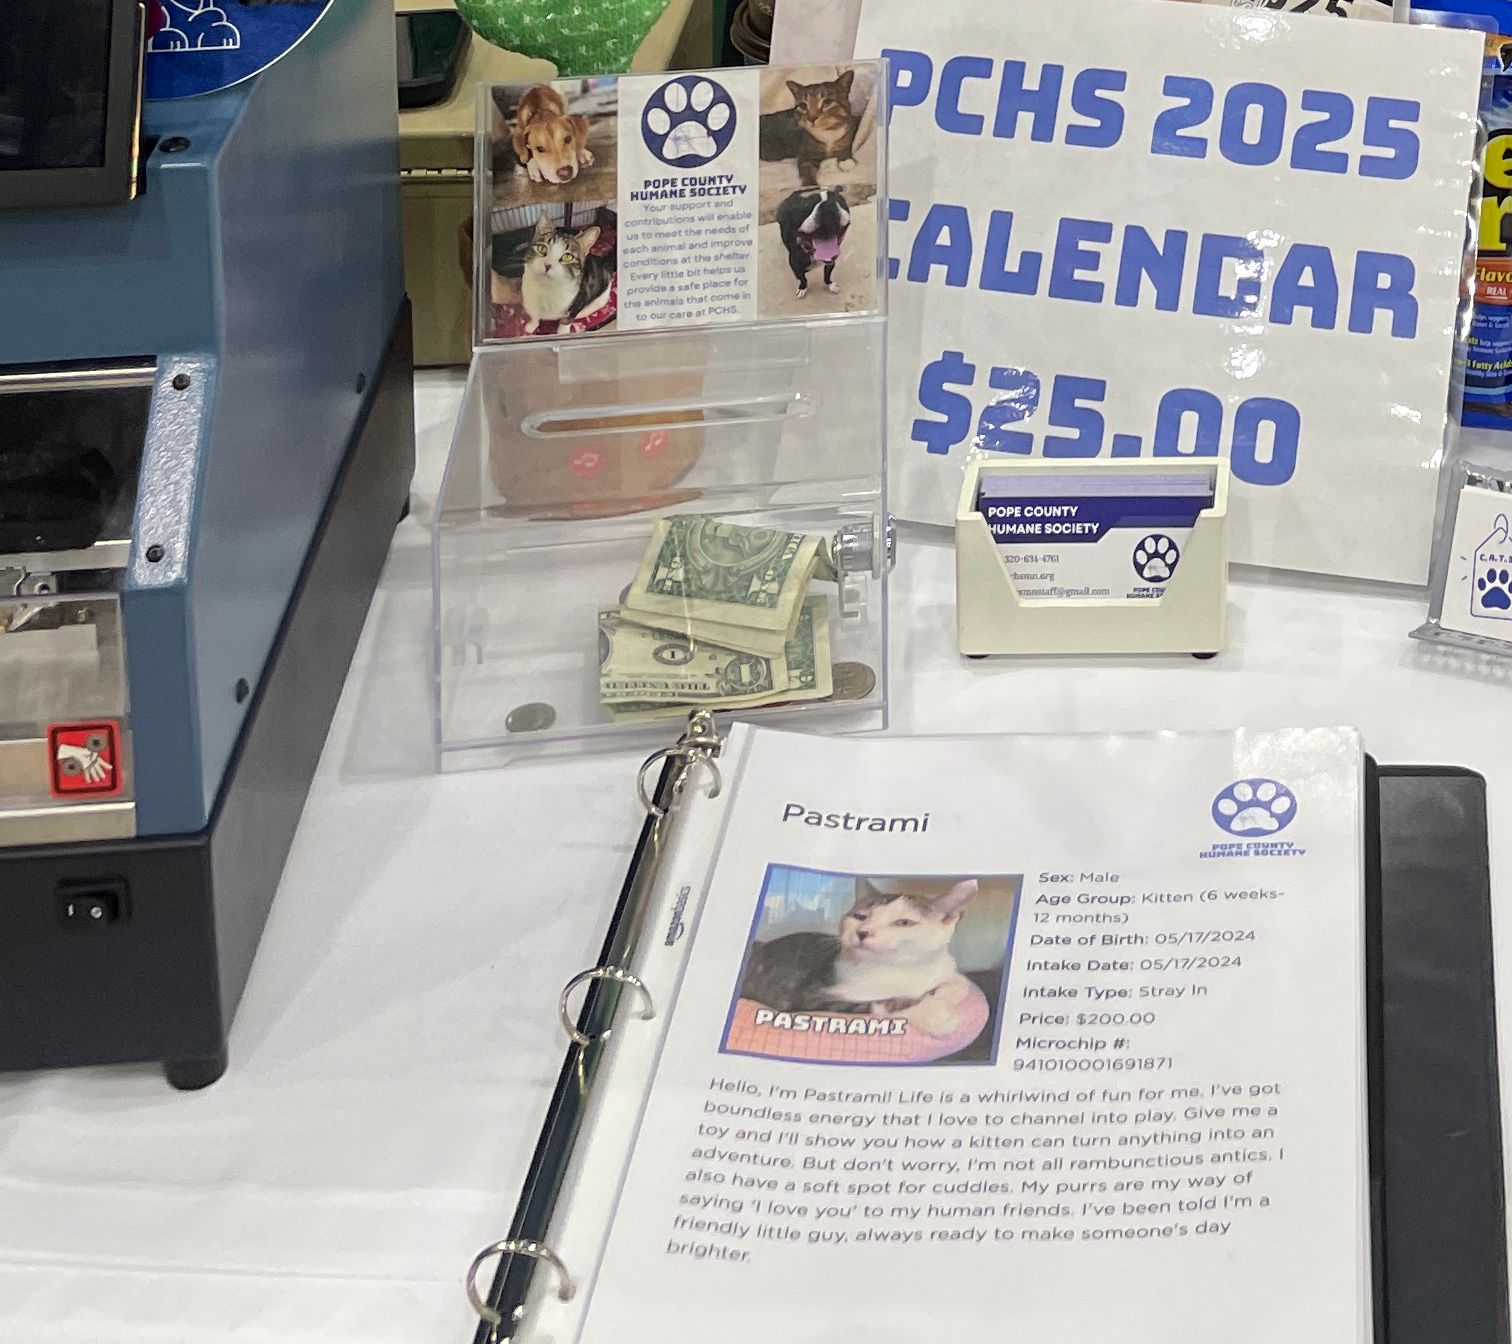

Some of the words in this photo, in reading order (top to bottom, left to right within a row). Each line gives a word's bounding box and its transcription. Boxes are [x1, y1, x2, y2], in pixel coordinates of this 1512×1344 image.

[880, 48, 1127, 149] PCHS
[1150, 75, 1422, 181] 2025
[644, 178, 678, 189] POPE
[682, 175, 734, 187] COUNTY
[630, 187, 686, 201] HUMANE
[689, 185, 747, 198] SOCIETY
[910, 350, 1301, 487] $25.00
[988, 506, 1022, 518] POPE
[1024, 506, 1078, 517] COUNTY
[988, 524, 1042, 534] HUMANE
[1044, 522, 1100, 534] SOCIETY
[1004, 554, 1060, 564] 320-634-4761
[781, 802, 931, 834] Pastrami
[1039, 872, 1074, 884] Sex:
[1080, 872, 1120, 883] Male
[1036, 894, 1073, 905] Age
[1077, 893, 1136, 905] Group:
[1142, 892, 1193, 904] Kitten
[1200, 890, 1218, 902] (6
[1224, 888, 1285, 900] weeks-
[1033, 913, 1050, 923] 12
[1056, 913, 1129, 924] months)
[1030, 935, 1072, 946] Date
[1078, 934, 1096, 946] of
[1101, 934, 1149, 946] Birth:
[1154, 930, 1256, 945] 05/17/2024
[1026, 960, 1081, 971] Intake
[1087, 960, 1134, 971] Date:
[1140, 956, 1242, 970] 05/17/2024
[1022, 987, 1078, 998] Intake
[1084, 986, 1132, 1000] Type:
[1139, 985, 1186, 998] Stray
[1192, 985, 1208, 996] In
[753, 1009, 908, 1037] PASTRAMI
[1019, 1013, 1070, 1024] Price:
[1076, 1012, 1156, 1025] $200.00
[1016, 1038, 1107, 1051] Microchip
[1013, 1057, 1172, 1072] 941010001691871
[769, 1085, 797, 1100] I'm
[804, 1088, 892, 1104] Pastrami!
[899, 1090, 934, 1104] Life
[940, 1091, 953, 1103] is
[960, 1093, 970, 1103] a
[978, 1090, 1069, 1103] whirlwind
[1076, 1090, 1096, 1102] of
[1101, 1090, 1131, 1102] fun
[1138, 1088, 1164, 1100] for
[1211, 1084, 1242, 1096] I've
[1249, 1082, 1281, 1097] got
